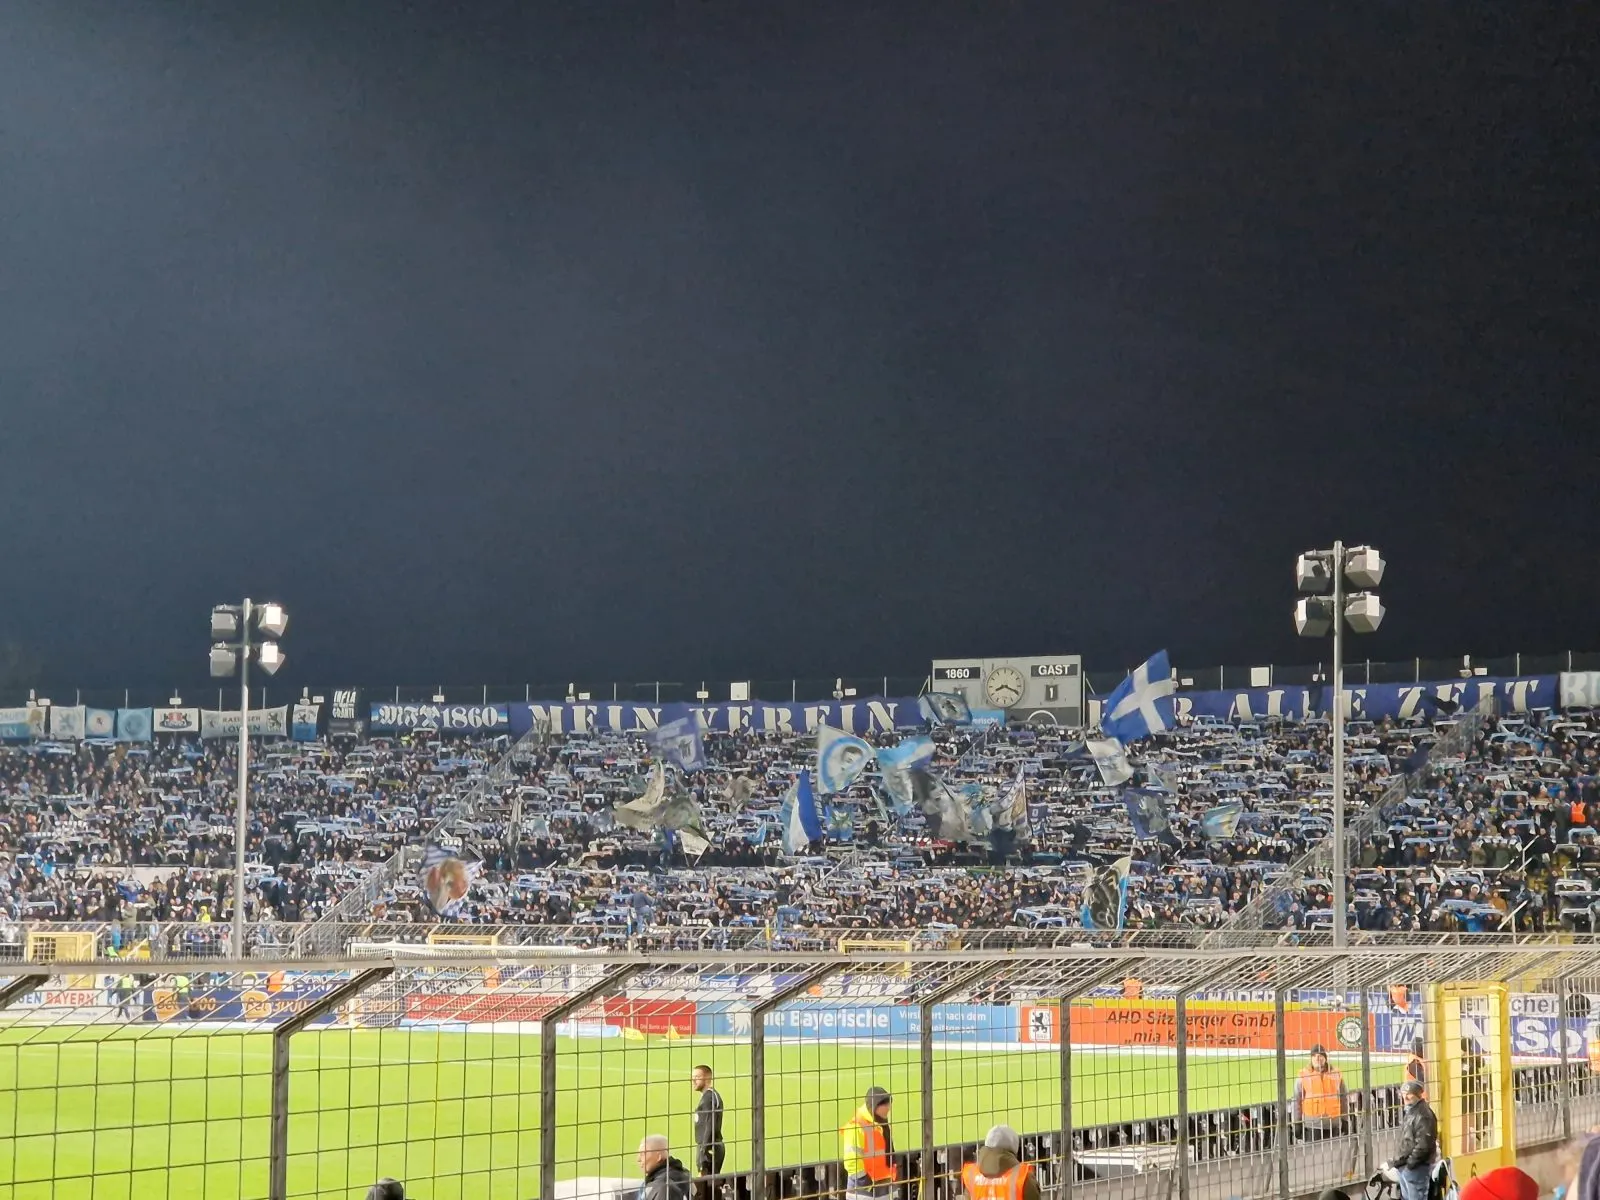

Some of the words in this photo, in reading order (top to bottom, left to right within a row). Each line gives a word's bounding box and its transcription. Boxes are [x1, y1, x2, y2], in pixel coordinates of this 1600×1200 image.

[945, 668, 970, 679] 1860
[1037, 664, 1071, 676] GAST
[528, 704, 663, 734] MEIN
[688, 701, 899, 736] VEREIN
[46, 991, 96, 1006] BAYERN
[790, 1008, 889, 1030] Bayerische
[1106, 1010, 1142, 1025] AHD
[1146, 1012, 1227, 1030] Sitzerger
